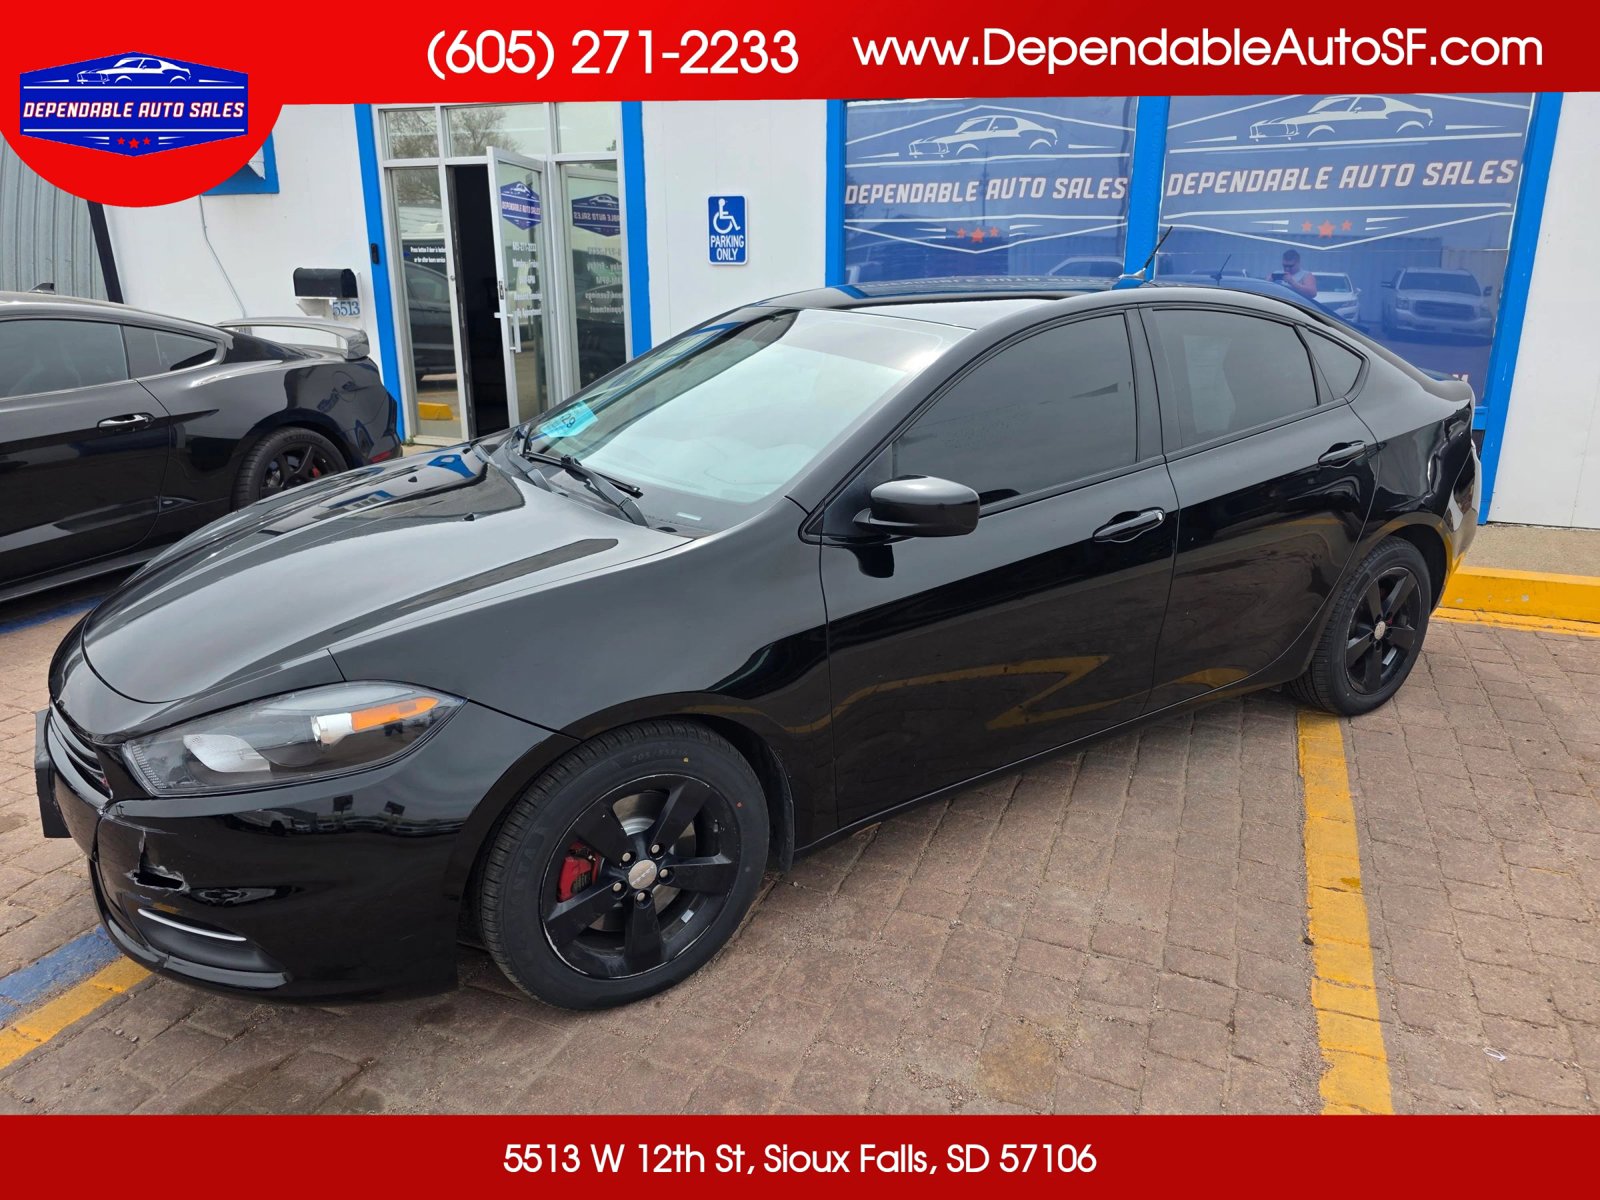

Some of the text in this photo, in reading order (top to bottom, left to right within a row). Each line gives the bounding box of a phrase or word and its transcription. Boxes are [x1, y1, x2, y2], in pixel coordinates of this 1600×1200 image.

[845, 177, 1129, 204] DEPENDABLE AUTO SALES
[1166, 159, 1519, 197] DEPENDABLE AUTO SALES
[710, 235, 744, 261] PARKING ONLY
[332, 301, 360, 316] 5513
